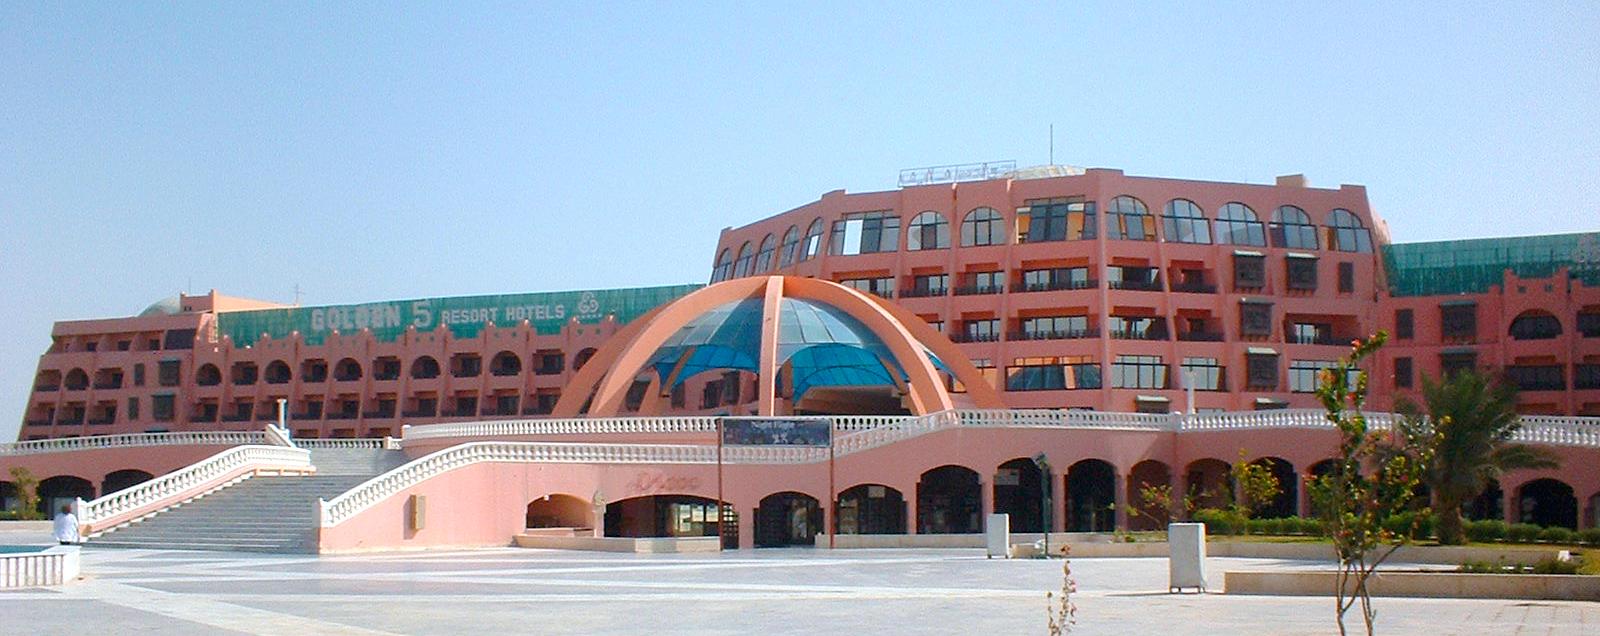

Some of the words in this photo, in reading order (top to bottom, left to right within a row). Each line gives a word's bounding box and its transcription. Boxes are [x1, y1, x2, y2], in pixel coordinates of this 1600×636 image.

[412, 300, 432, 328] 5
[441, 308, 498, 324] RESORT
[506, 305, 565, 321] HOTELS
